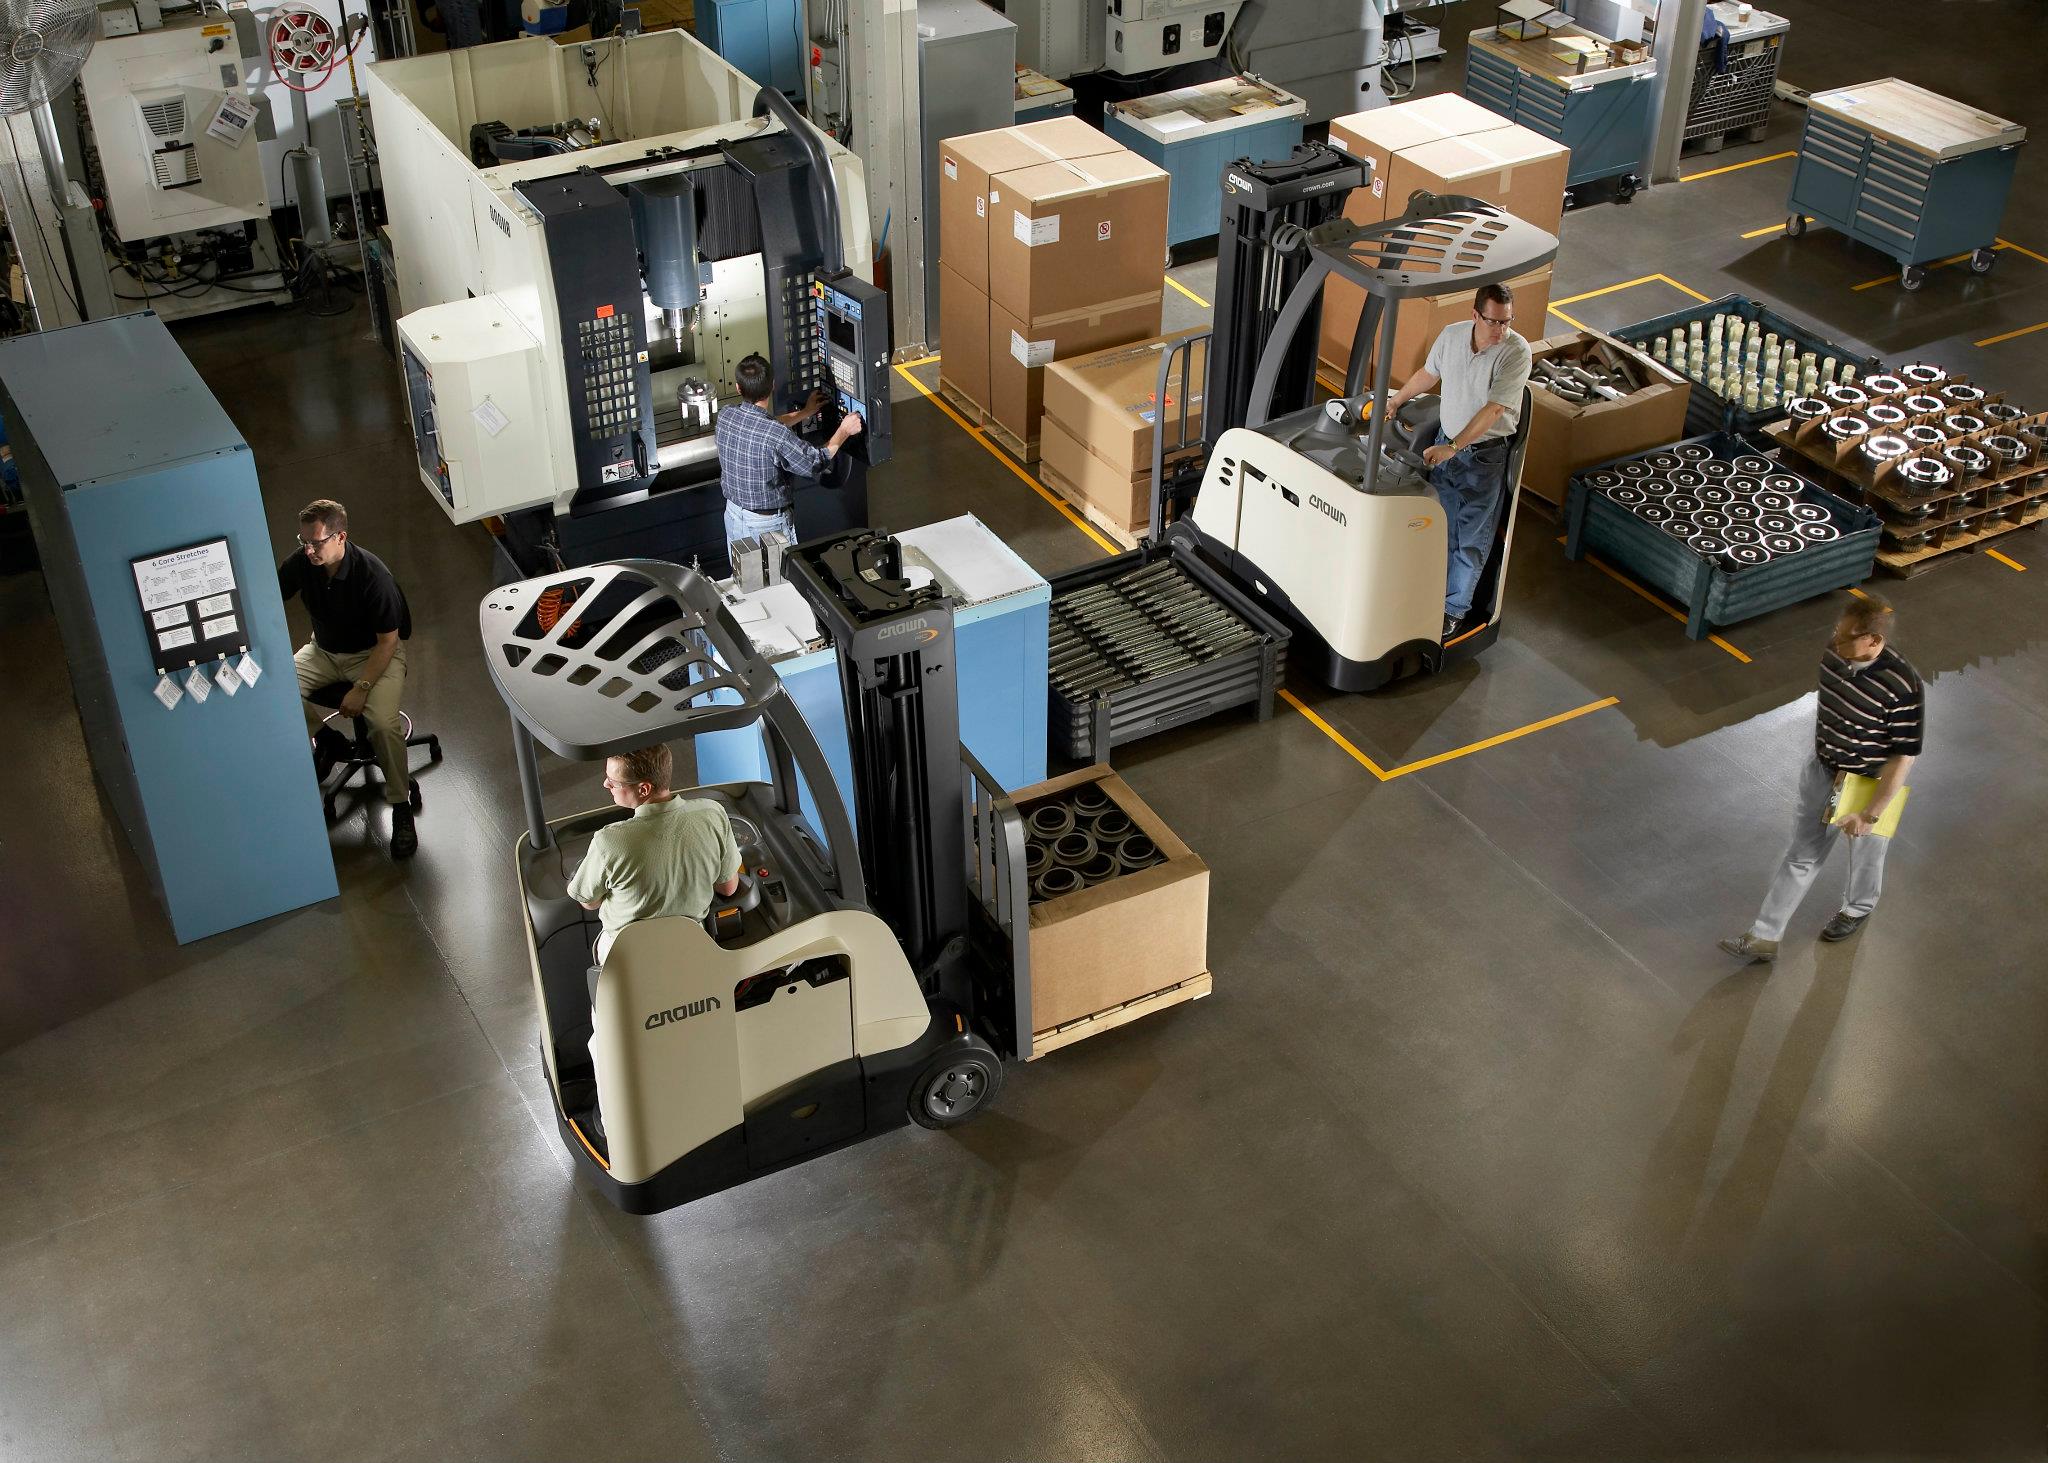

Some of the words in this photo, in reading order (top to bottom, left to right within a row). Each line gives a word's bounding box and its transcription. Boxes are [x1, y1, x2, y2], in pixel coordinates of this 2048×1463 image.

[1228, 173, 1253, 194] CROWN
[1302, 181, 1335, 193] crown.com
[1308, 494, 1347, 527] CROWN
[158, 556, 175, 566] Core
[176, 548, 209, 560] Stretches
[877, 617, 928, 640] CROWN
[644, 996, 721, 1031] CROWN
